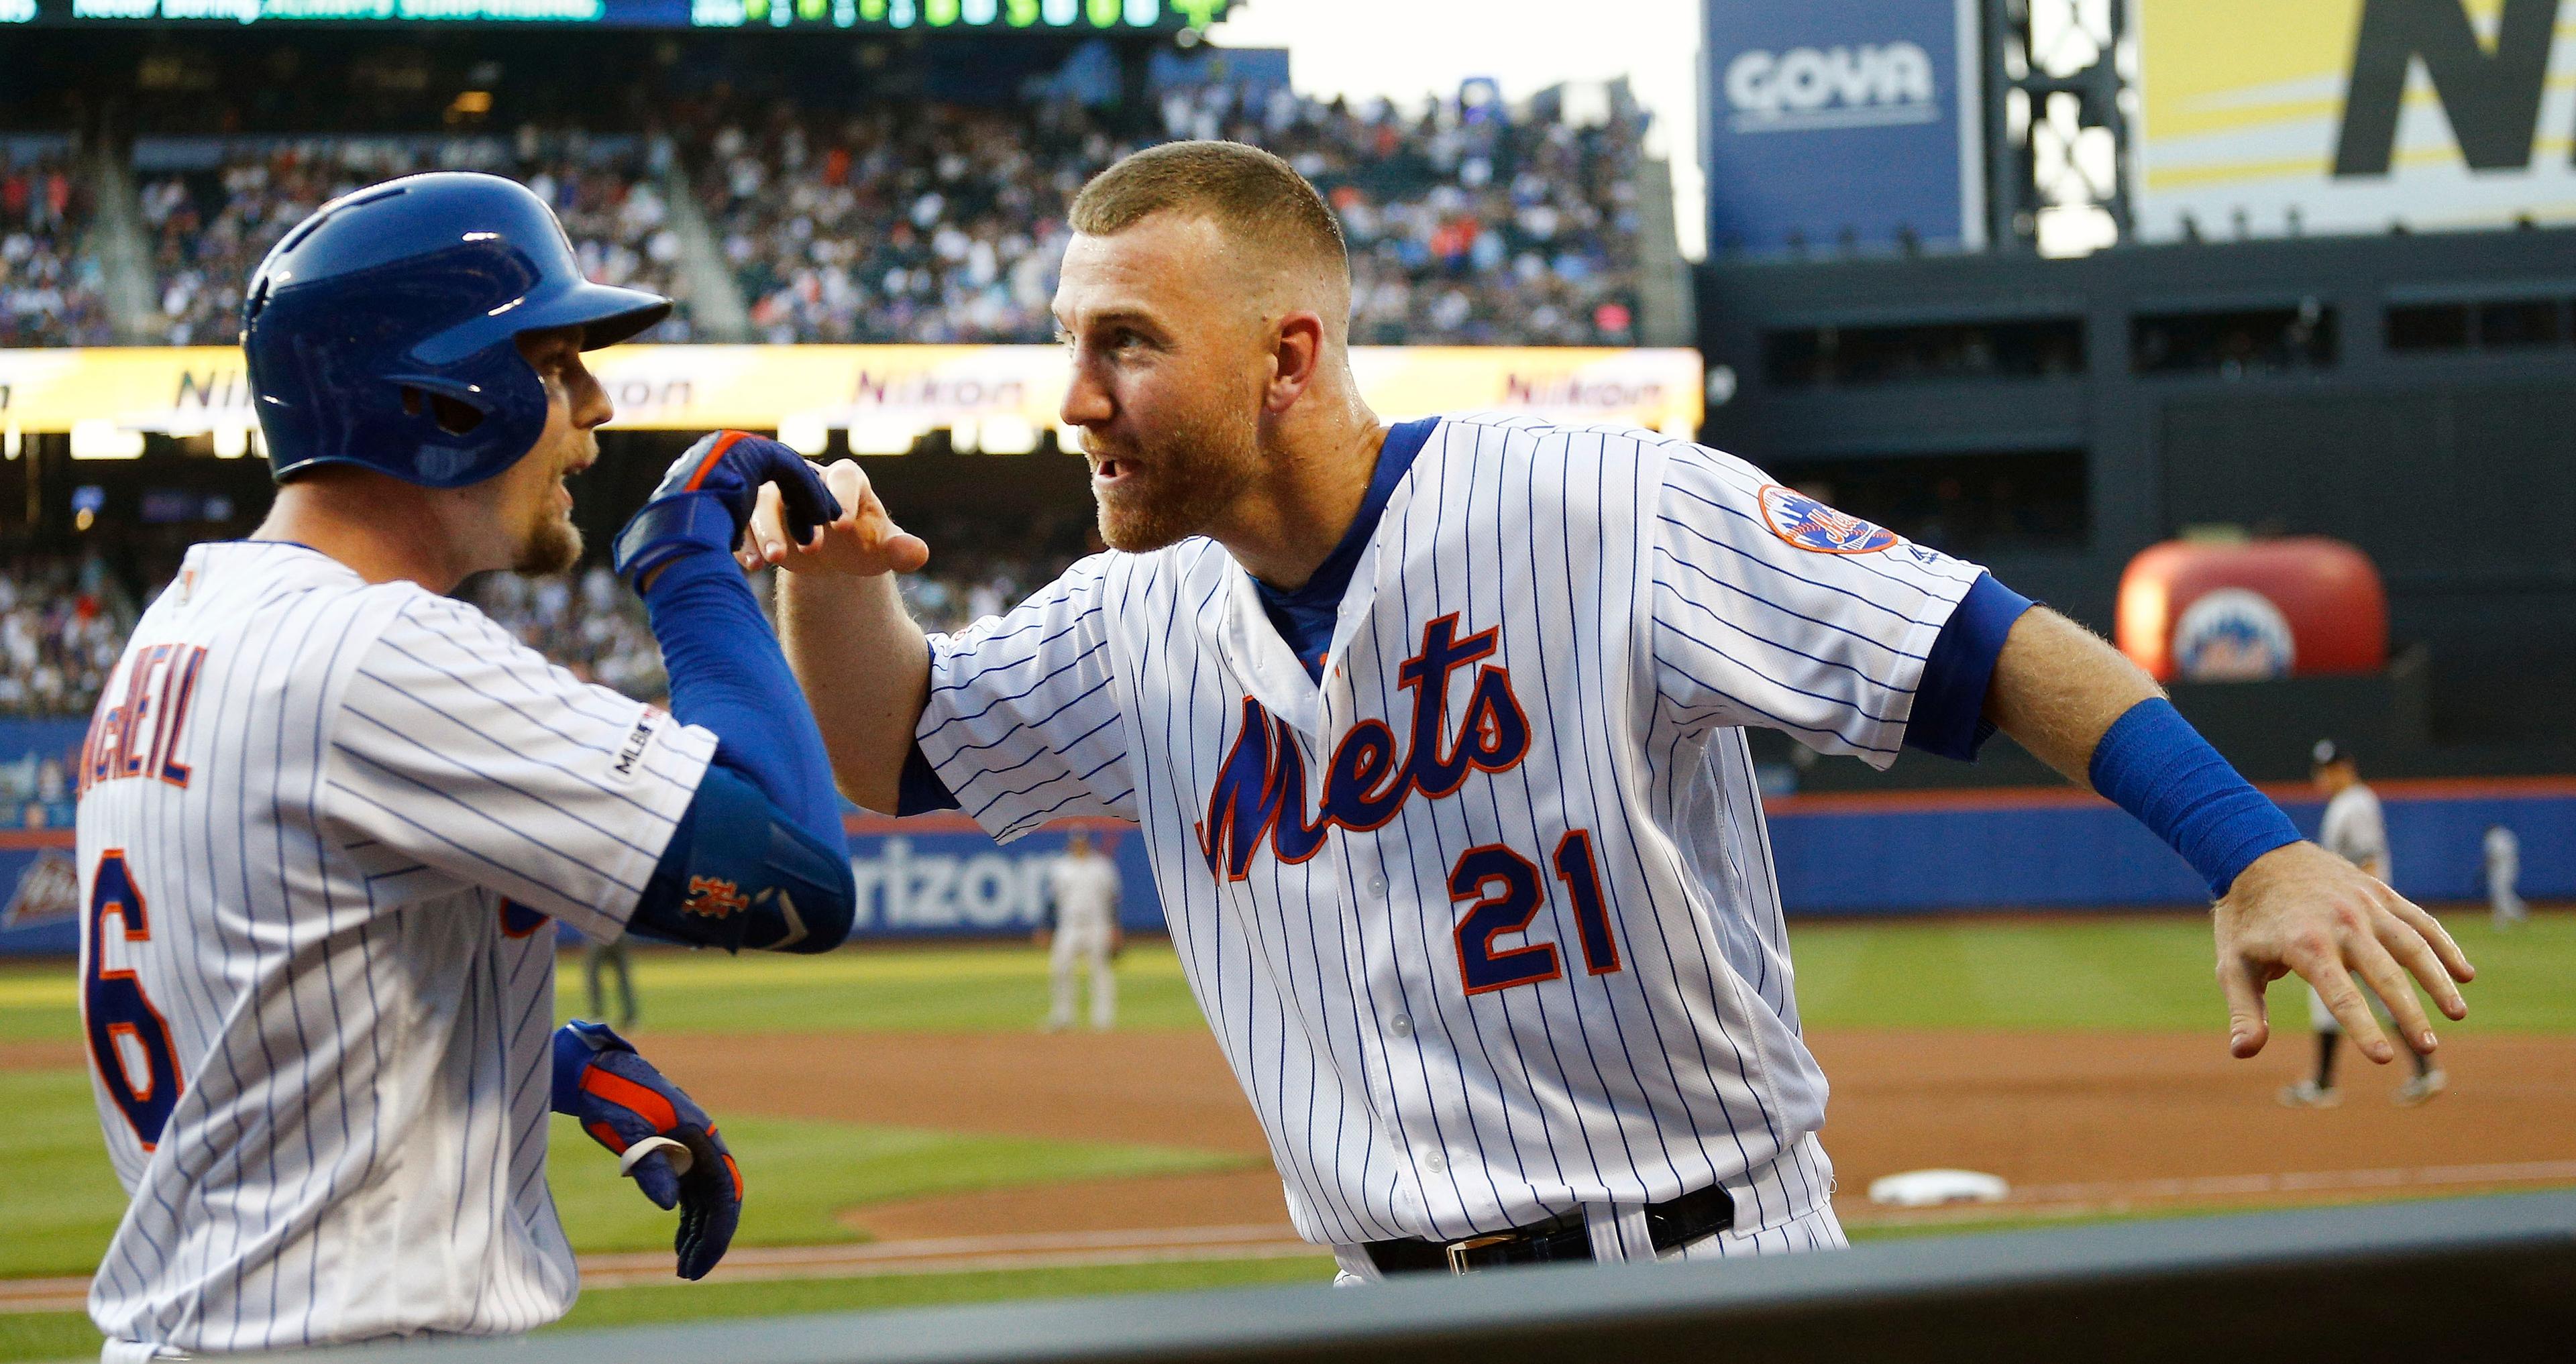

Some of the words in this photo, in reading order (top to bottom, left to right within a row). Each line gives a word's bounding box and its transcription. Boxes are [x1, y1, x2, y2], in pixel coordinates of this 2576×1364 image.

[1724, 42, 1937, 113] GOYA
[851, 369, 1026, 406] Nikon
[1194, 611, 1532, 887] Mets
[1446, 828, 1622, 997] 21
[85, 848, 186, 1152] 6
